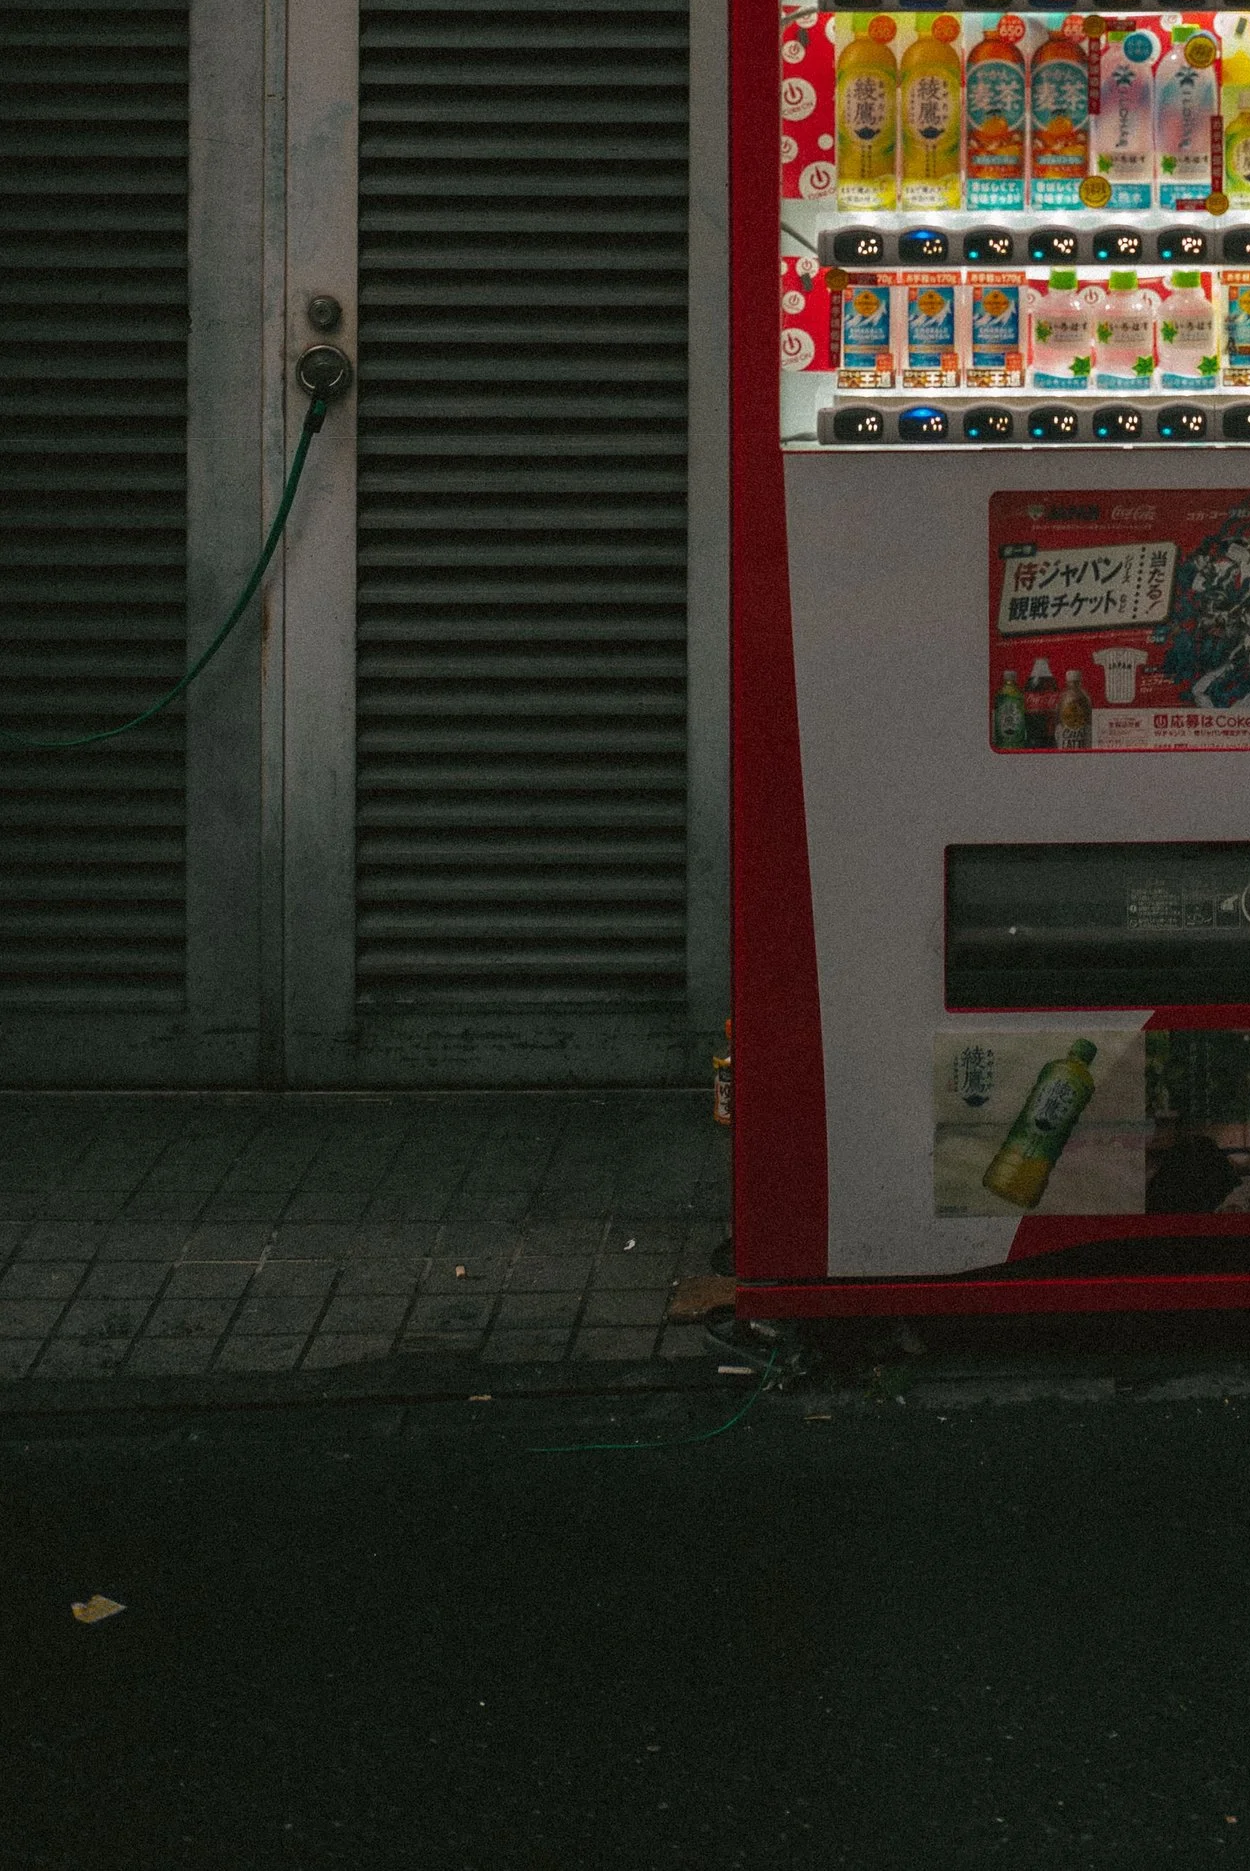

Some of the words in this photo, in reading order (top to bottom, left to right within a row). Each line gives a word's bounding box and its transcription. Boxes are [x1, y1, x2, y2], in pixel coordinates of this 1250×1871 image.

[1013, 556, 1124, 592] 侍ジャパン
[1145, 549, 1169, 615] 当たる!
[1007, 589, 1118, 622] 観戦チケット
[962, 1045, 987, 1093] 綾鷹
